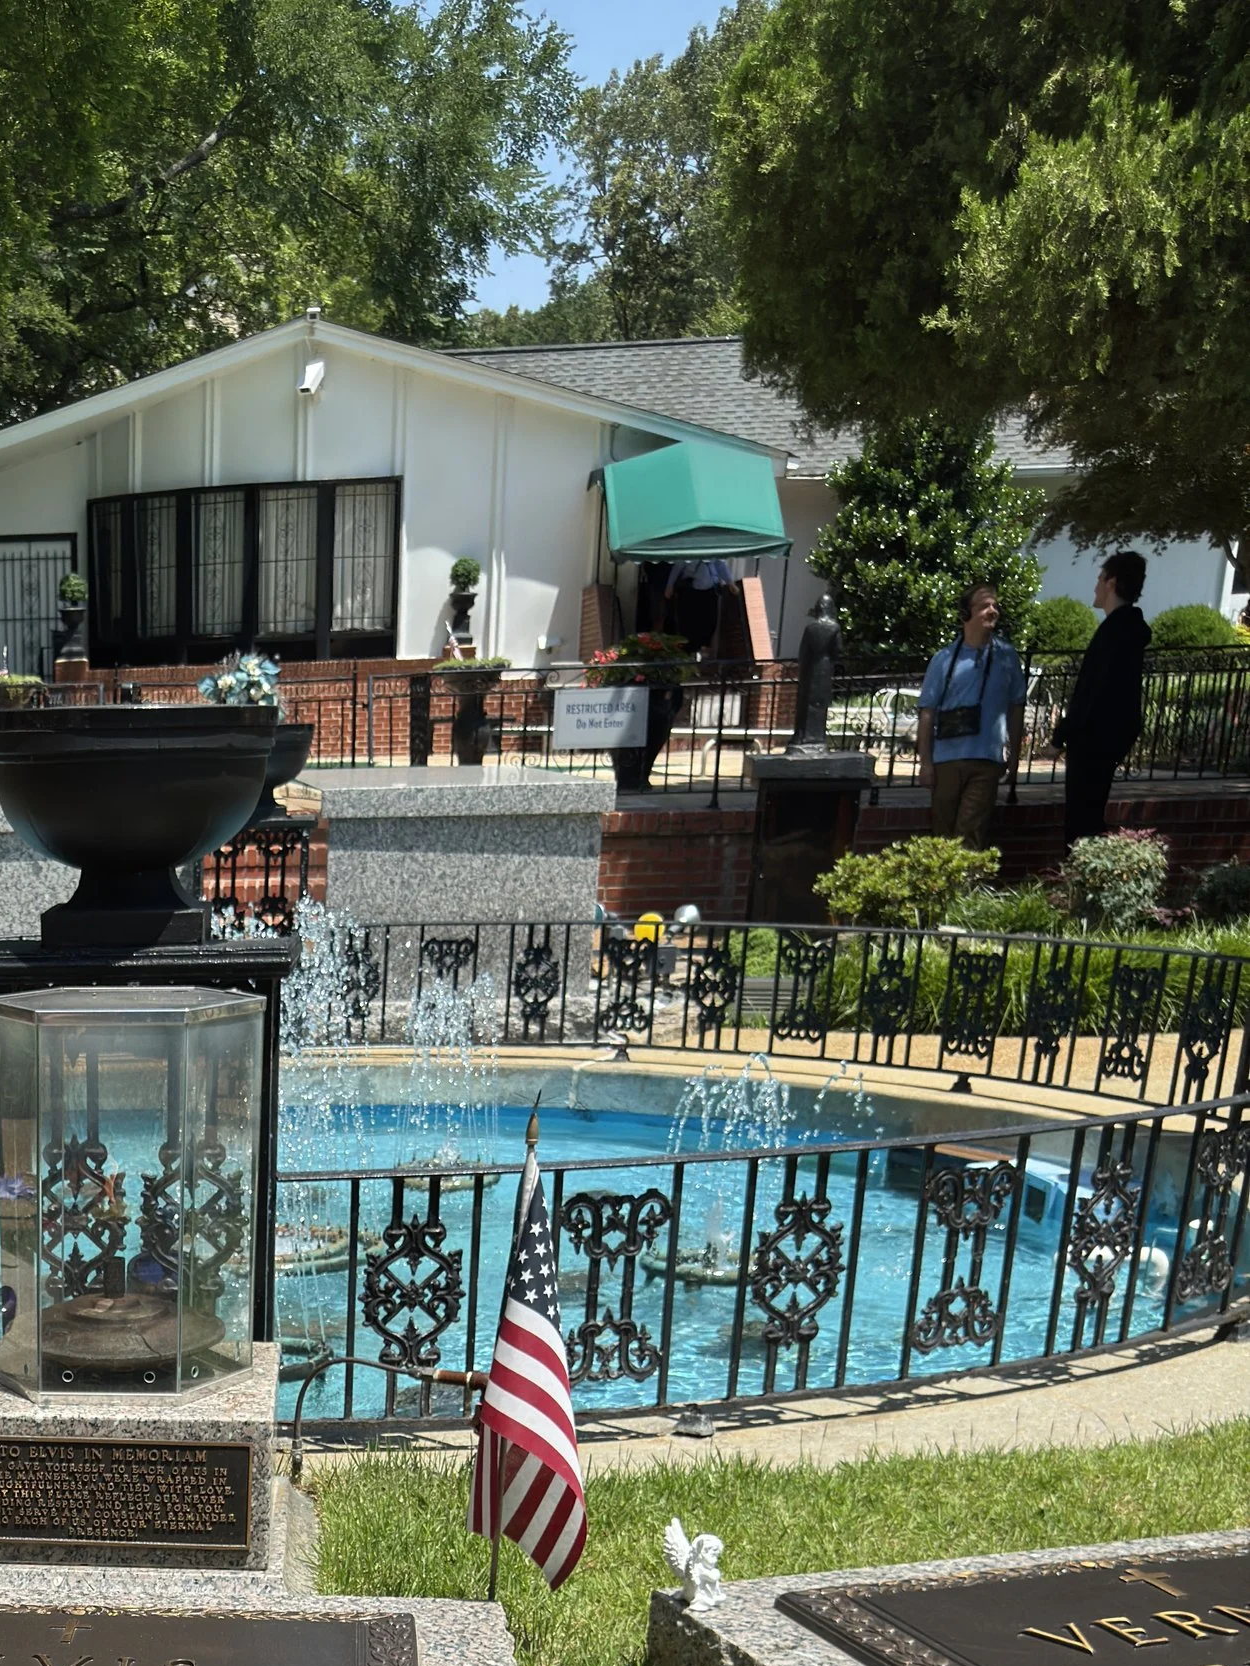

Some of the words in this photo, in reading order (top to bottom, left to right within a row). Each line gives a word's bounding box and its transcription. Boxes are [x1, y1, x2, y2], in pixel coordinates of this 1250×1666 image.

[566, 703, 613, 715] RESTRICTED
[616, 703, 636, 713] AREA
[576, 719, 586, 729] Do
[590, 719, 602, 729] Not
[604, 719, 624, 728] Enter
[0, 1445, 20, 1457] TO
[30, 1446, 74, 1459] ELVIS
[84, 1448, 103, 1460] IN
[112, 1448, 206, 1462] MEMORIAM
[8, 1462, 40, 1470] GAVE
[46, 1462, 105, 1472] YOURSELF
[112, 1465, 125, 1473] TO
[132, 1465, 164, 1474] EACH
[172, 1467, 187, 1475] OF
[194, 1467, 207, 1475] US
[214, 1468, 227, 1476] IN
[14, 1490, 41, 1498] THIS
[48, 1490, 89, 1499] FLAME
[96, 1492, 150, 1501] REFLECT
[155, 1494, 179, 1502] OUR
[184, 1495, 225, 1504] NEVER
